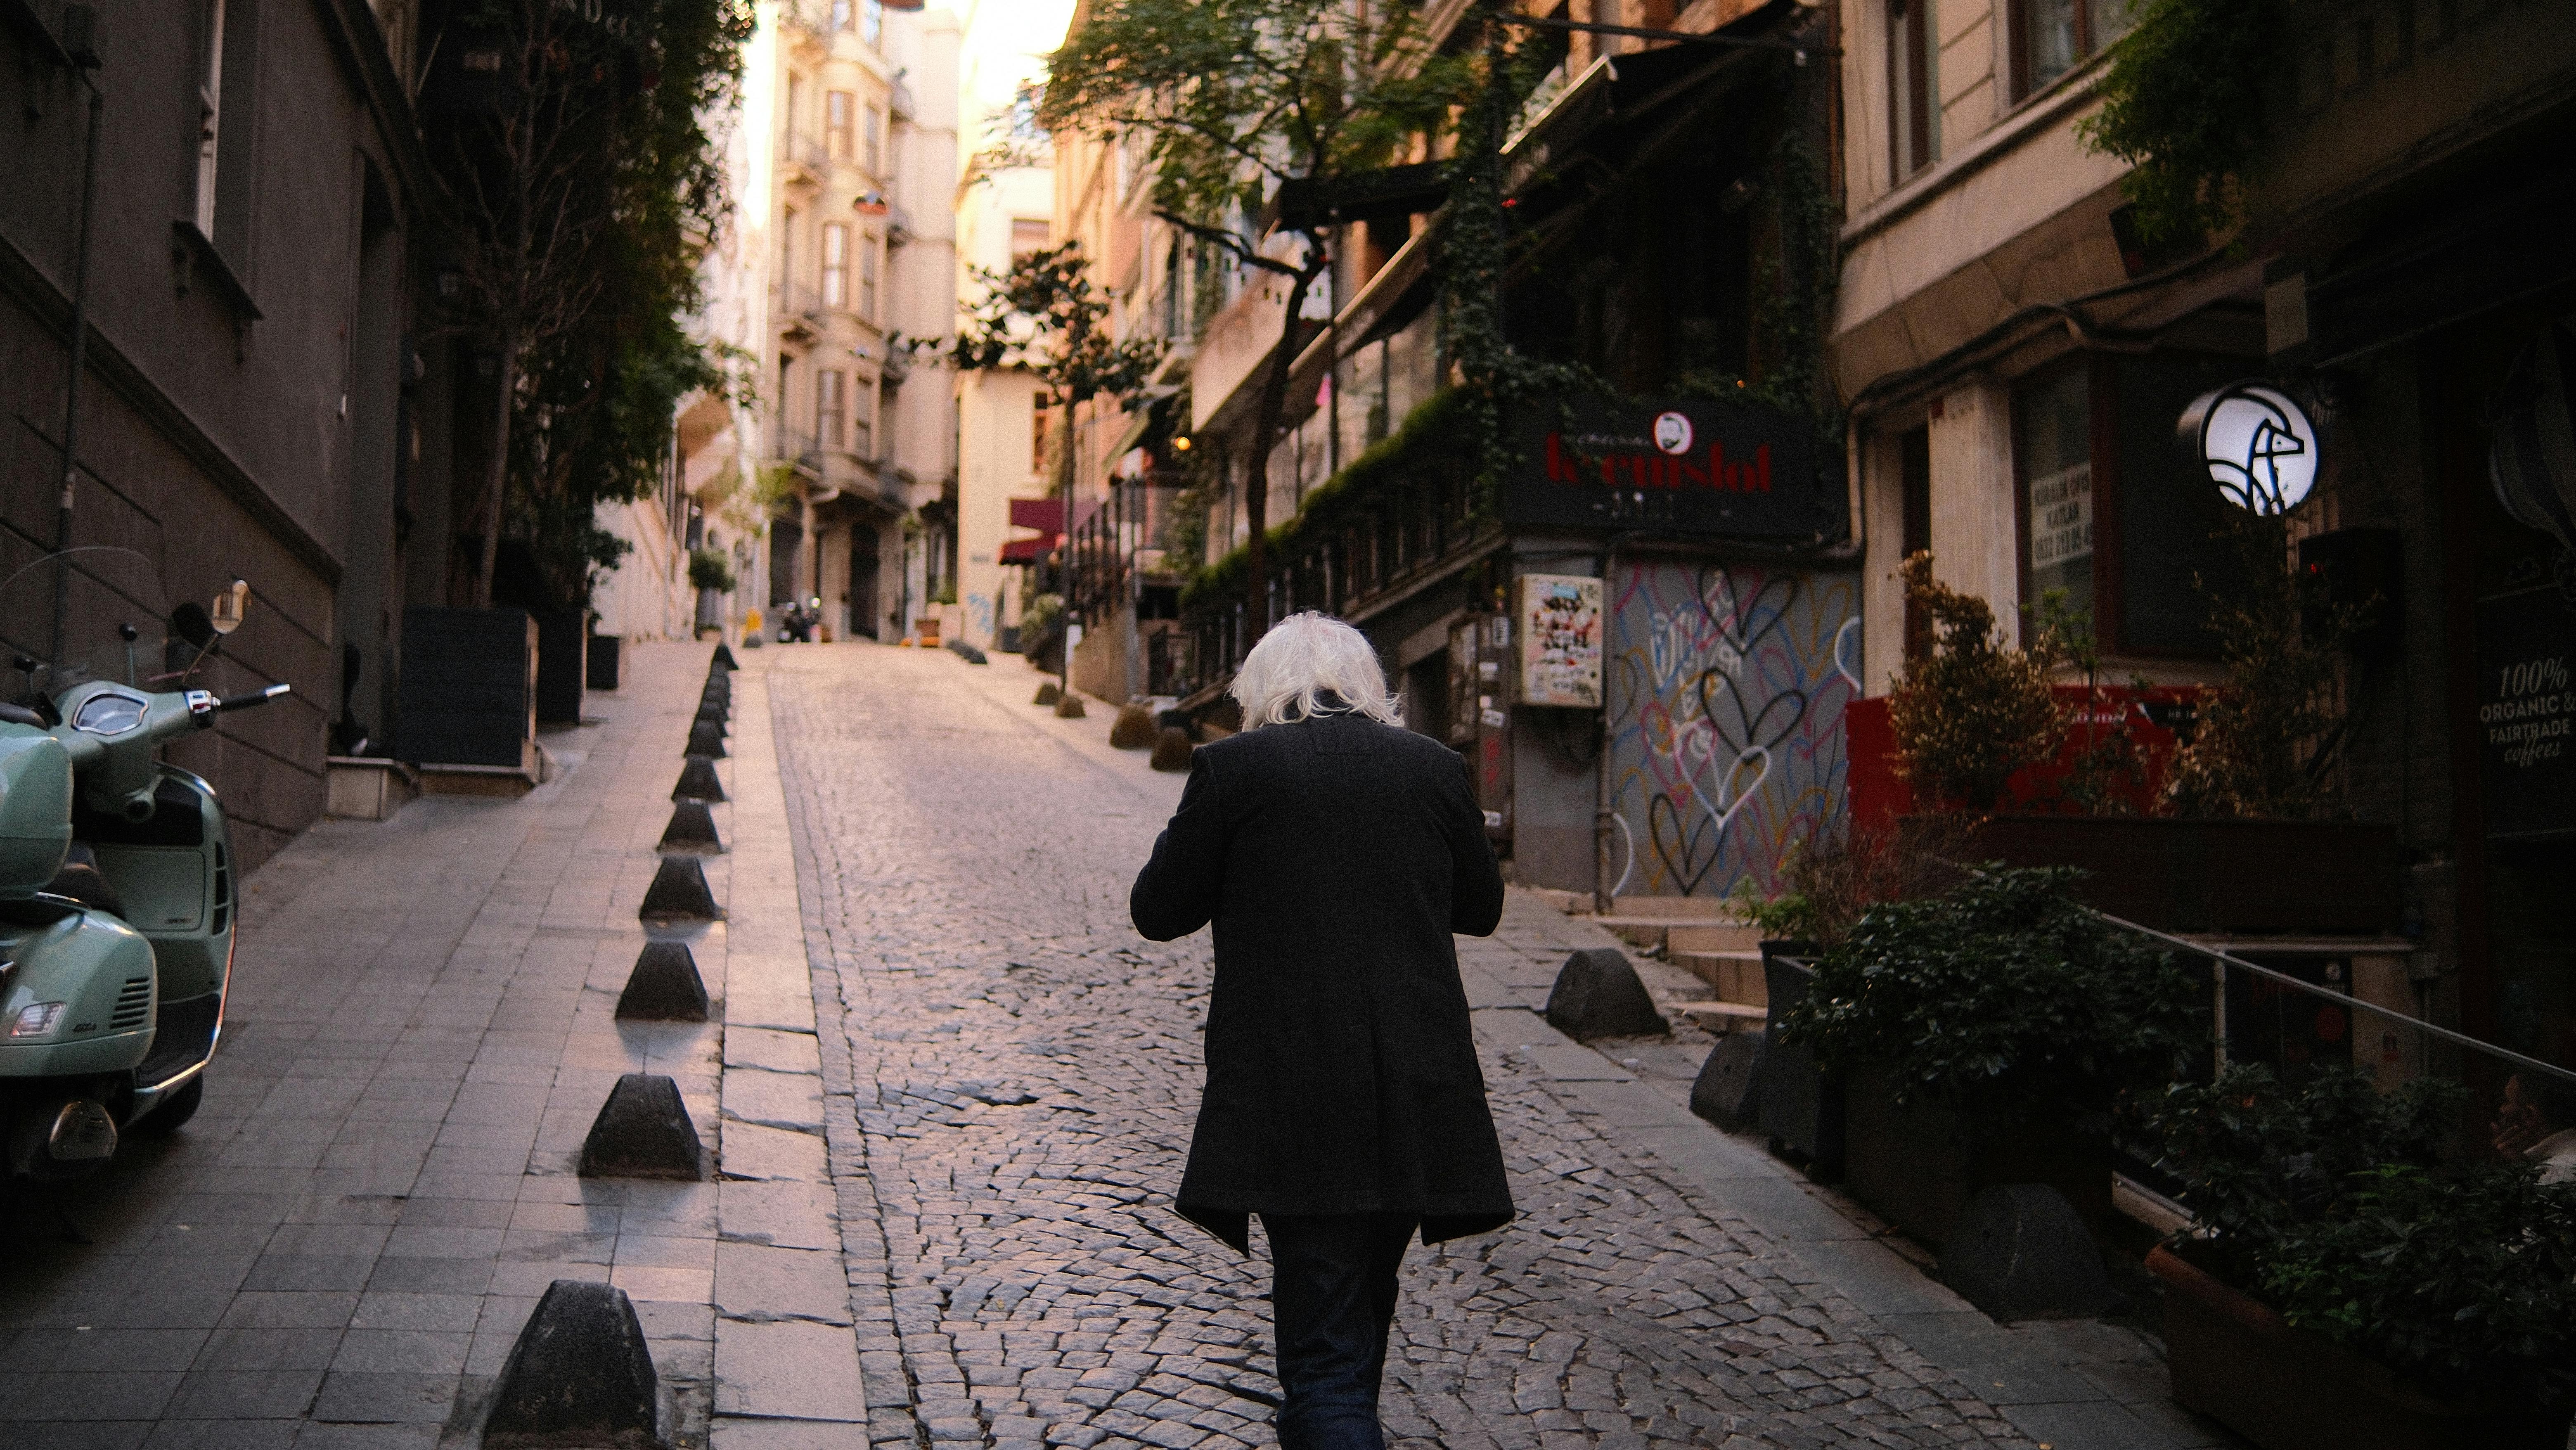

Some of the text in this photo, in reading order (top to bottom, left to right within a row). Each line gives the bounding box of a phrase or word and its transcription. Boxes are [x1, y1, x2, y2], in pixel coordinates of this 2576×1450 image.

[2500, 657, 2568, 697] 100%
[2479, 691, 2576, 724] ORGANIC &
[2489, 718, 2570, 744] FAIRTRADE
[2504, 735, 2560, 767] coffees
